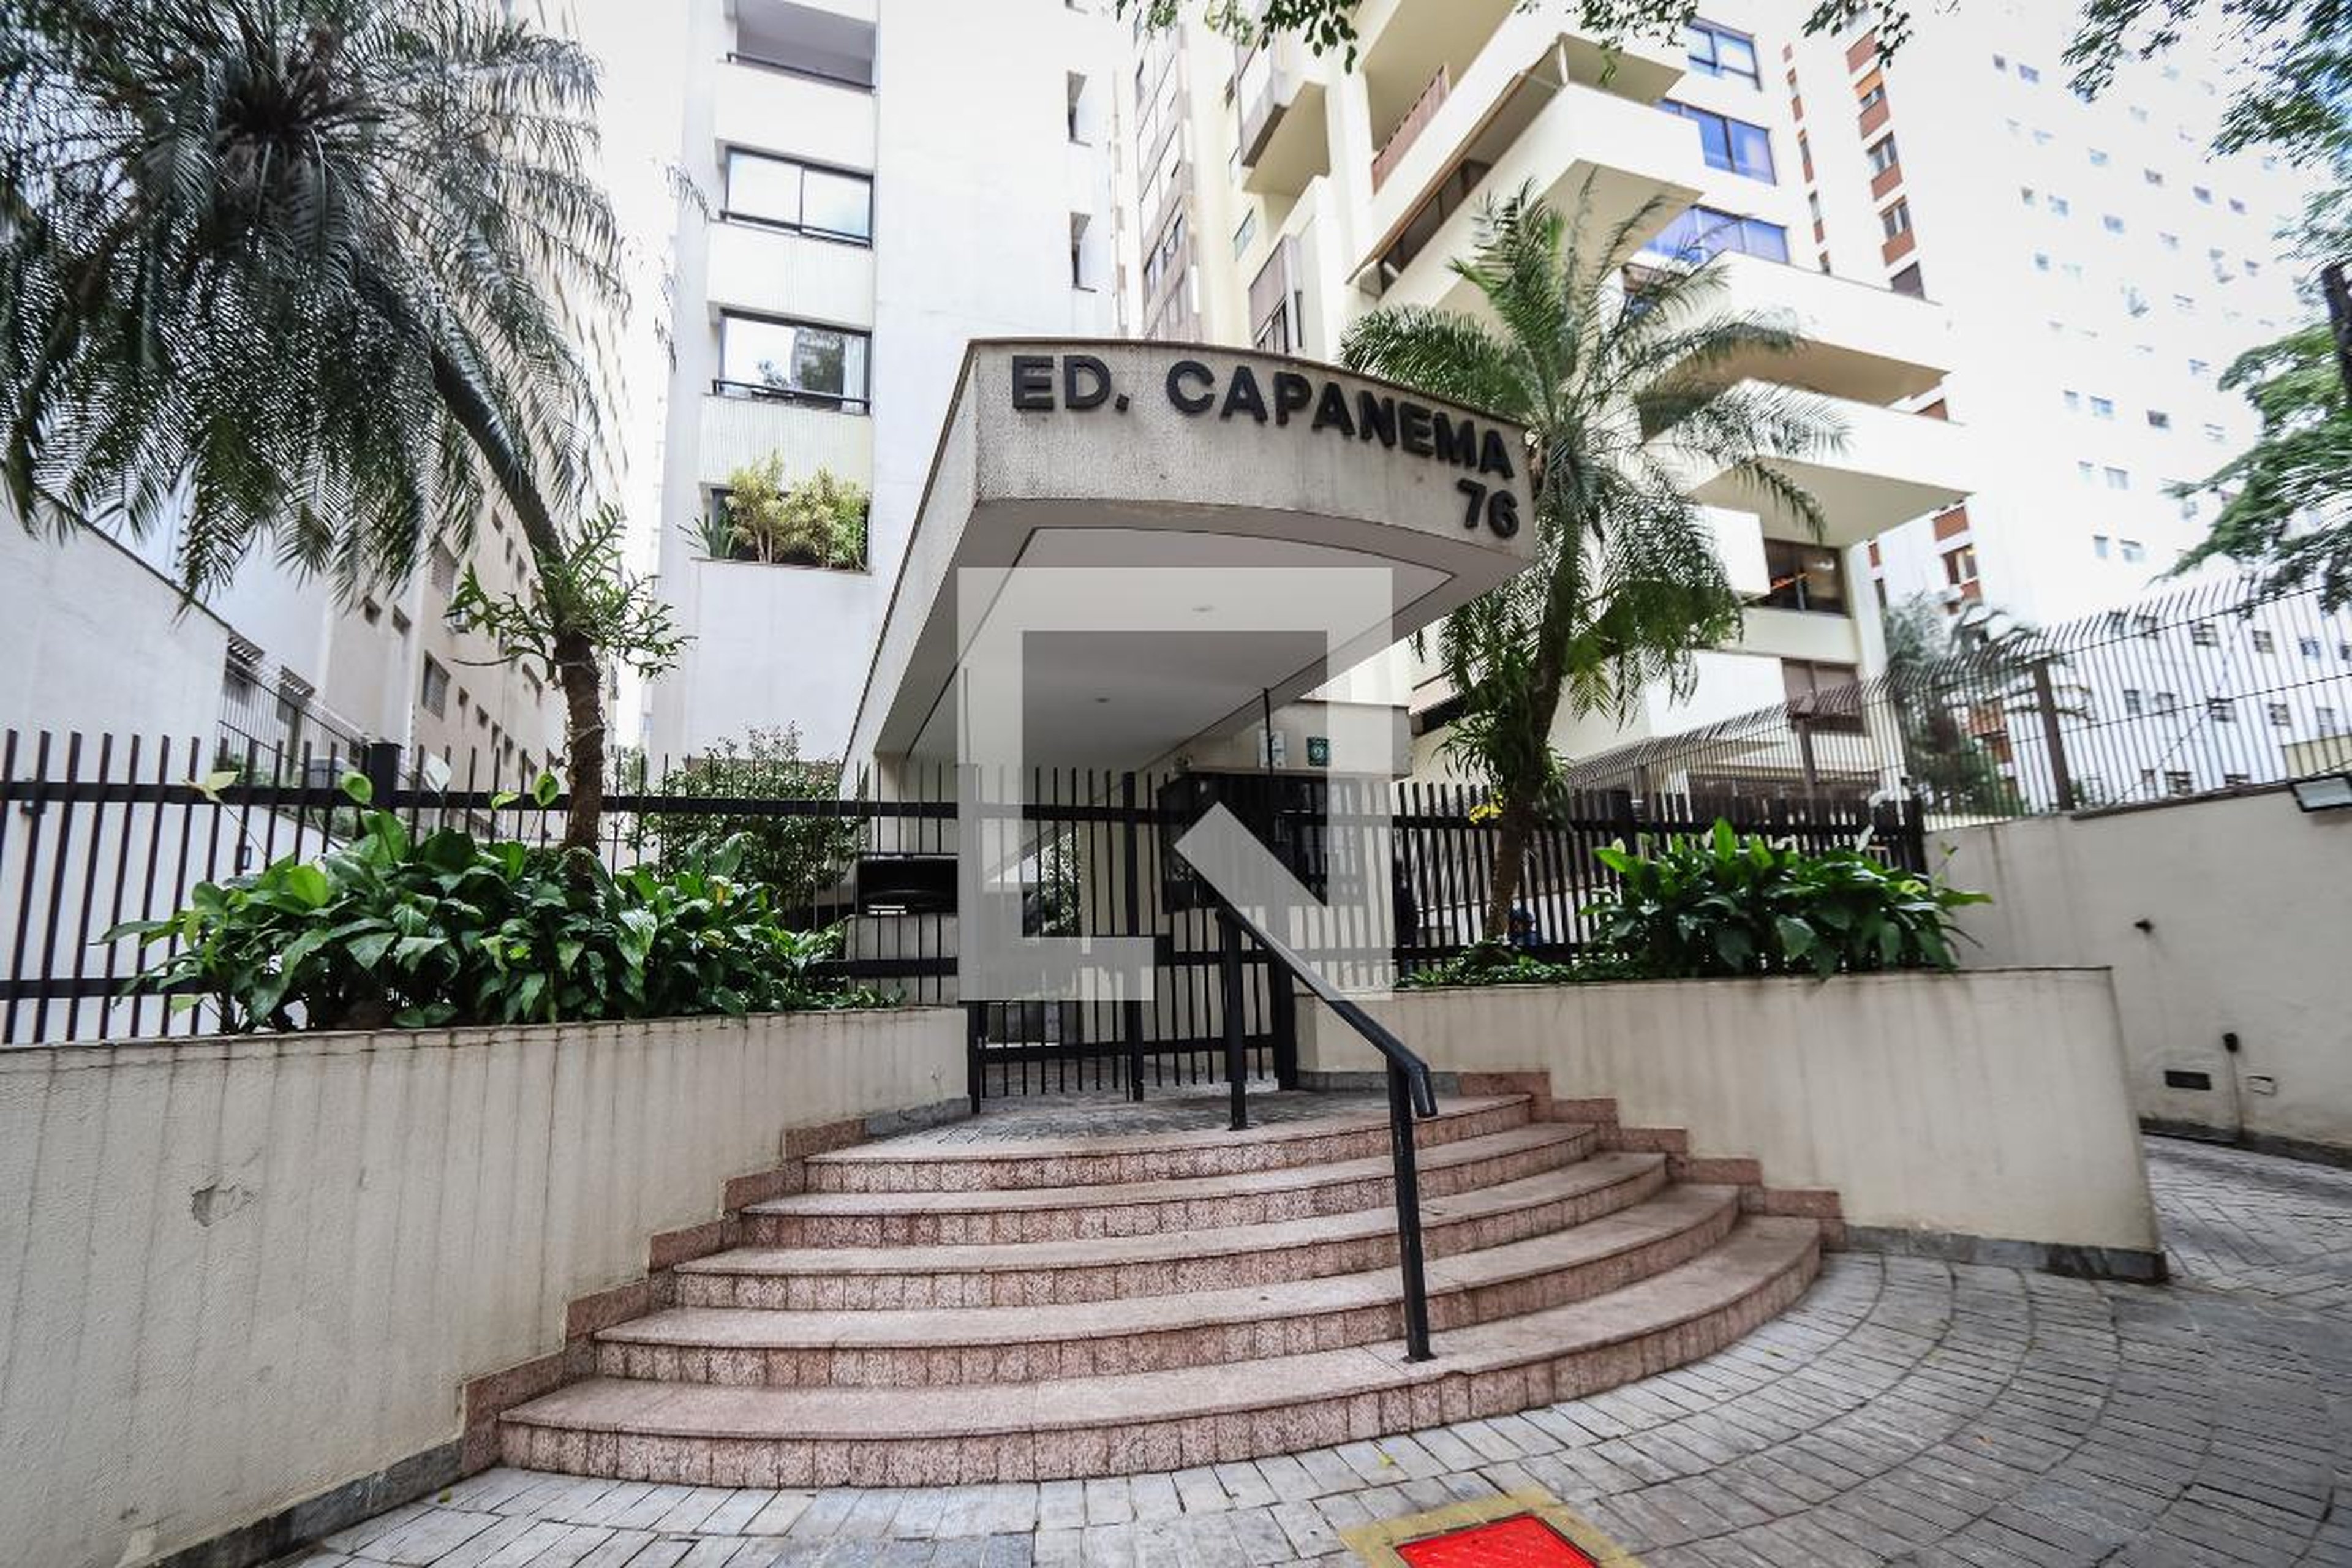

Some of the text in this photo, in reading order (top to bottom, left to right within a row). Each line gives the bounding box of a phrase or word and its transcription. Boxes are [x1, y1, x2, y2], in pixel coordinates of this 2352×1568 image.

[1012, 355, 1515, 479] ED. CAPANEMA
[1457, 478, 1520, 538] 76
